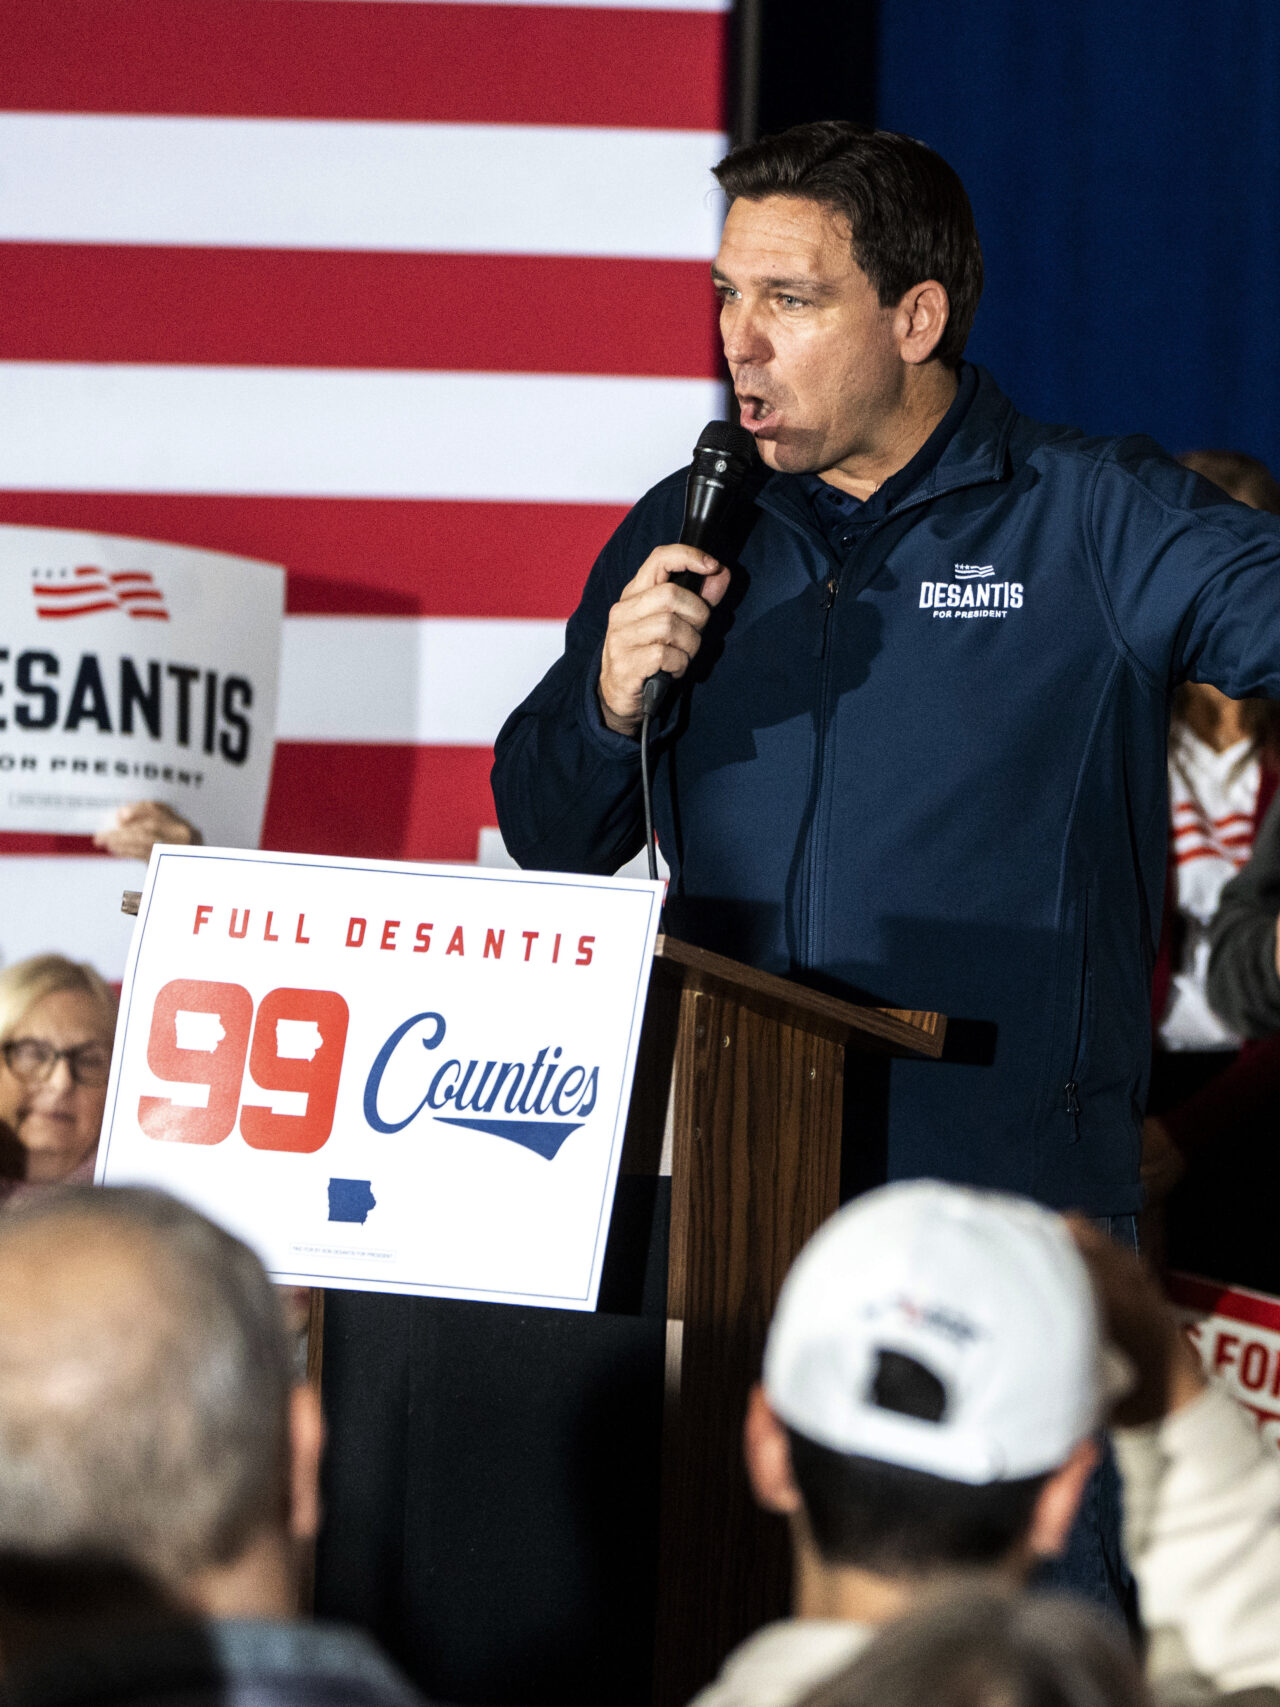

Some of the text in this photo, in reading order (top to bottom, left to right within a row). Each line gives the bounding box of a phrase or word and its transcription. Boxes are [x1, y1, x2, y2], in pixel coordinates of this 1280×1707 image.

[919, 582, 1024, 609] DESANTIS
[932, 610, 1008, 619] FOR PRESIDENT
[0, 649, 254, 766] SANTIS
[51, 757, 205, 788] PRESIDENT
[193, 905, 596, 967] FULL DESANTIS
[137, 978, 600, 1155] 99 Counties
